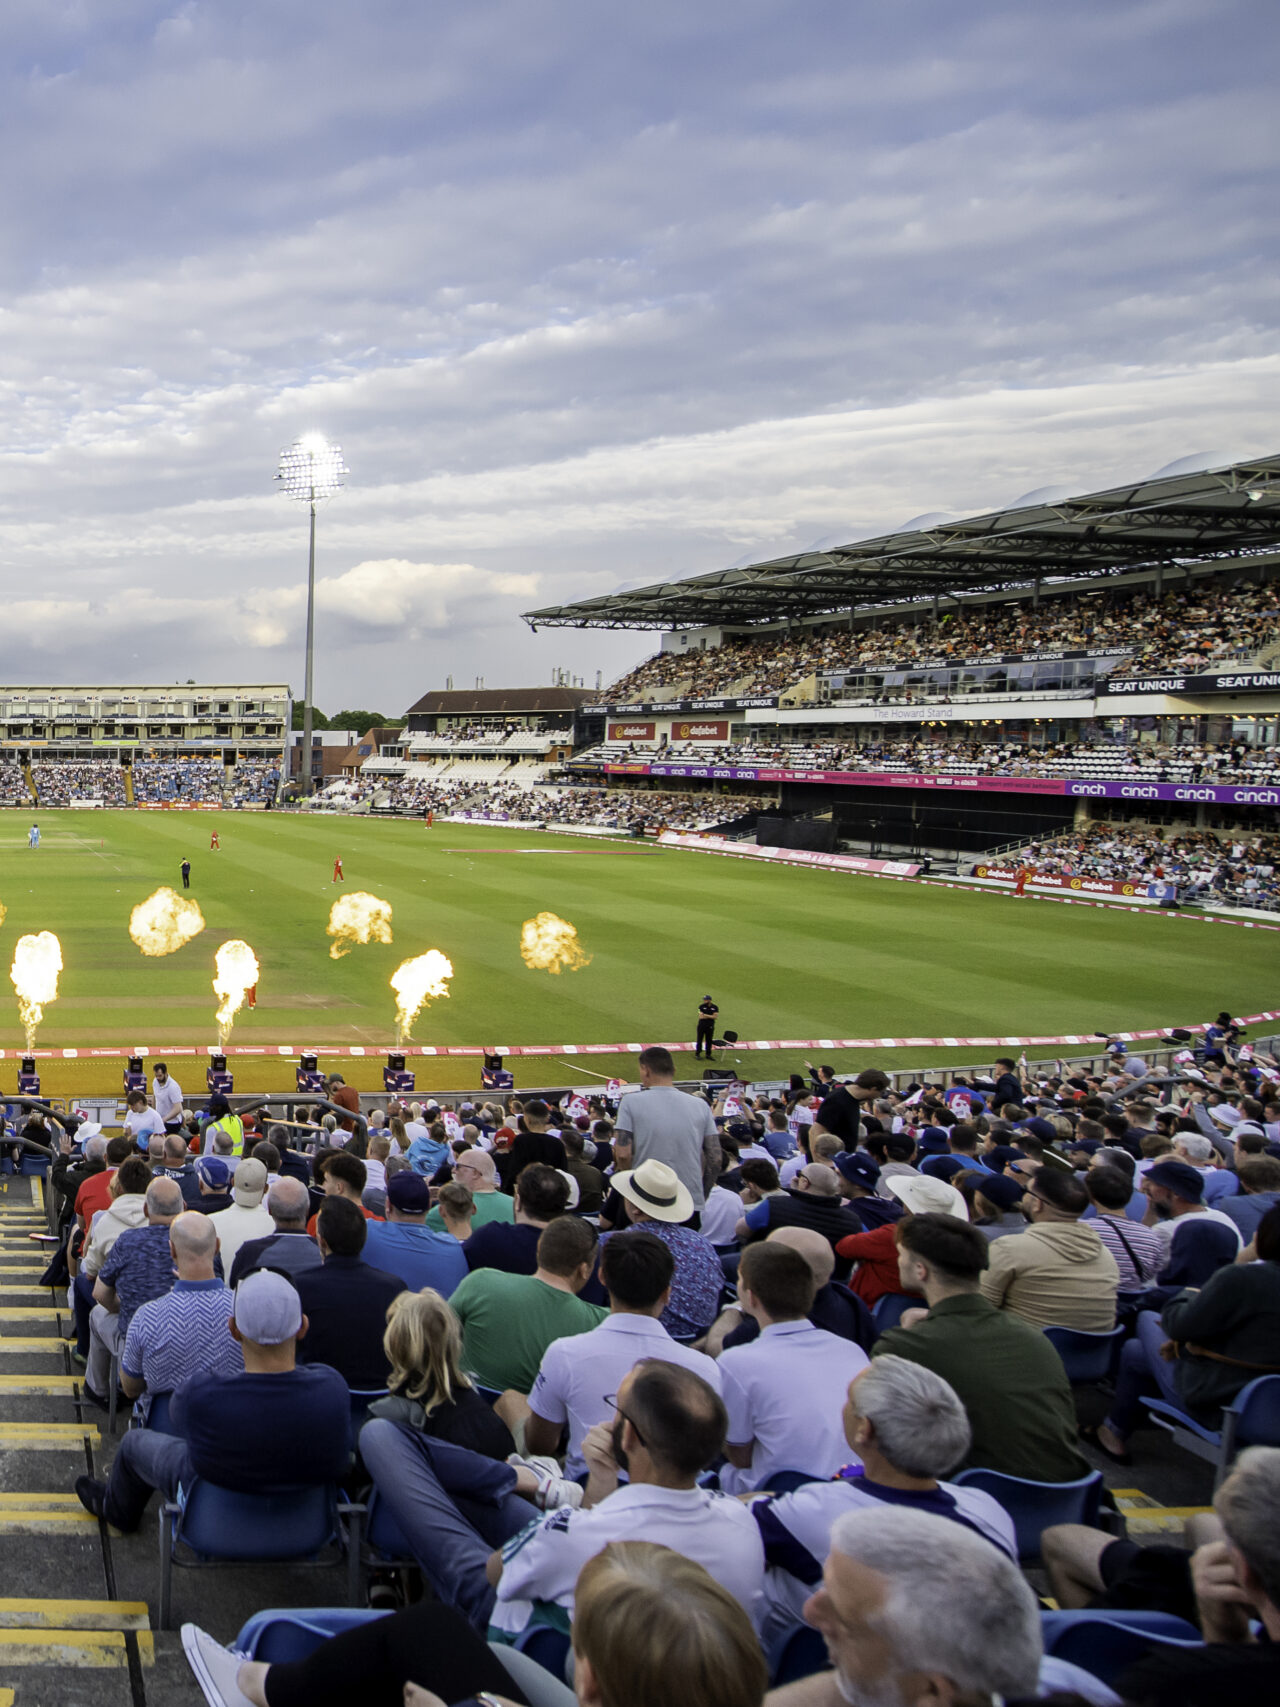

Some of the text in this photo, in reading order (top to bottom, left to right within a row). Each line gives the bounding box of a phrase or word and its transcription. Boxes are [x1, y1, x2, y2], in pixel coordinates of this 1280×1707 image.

[1022, 652, 1064, 662] SEAT UNIQUE
[1105, 648, 1134, 656] UNIQUE
[1108, 680, 1186, 692] SEAT UNIQUE
[1253, 675, 1280, 686] UNI
[873, 707, 952, 718] The Howard Stand
[624, 727, 646, 736] dafabet
[690, 725, 718, 736] dafabet
[737, 770, 754, 778] cinch
[1072, 782, 1106, 795] cinch
[1121, 784, 1158, 798] cinch
[1175, 786, 1216, 800] cinch
[1234, 788, 1278, 804] cinch
[788, 852, 812, 861] Health
[819, 855, 832, 864] Life
[987, 869, 1014, 880] dafabet
[1032, 874, 1062, 886] dafabet
[1082, 880, 1114, 892] dafabet
